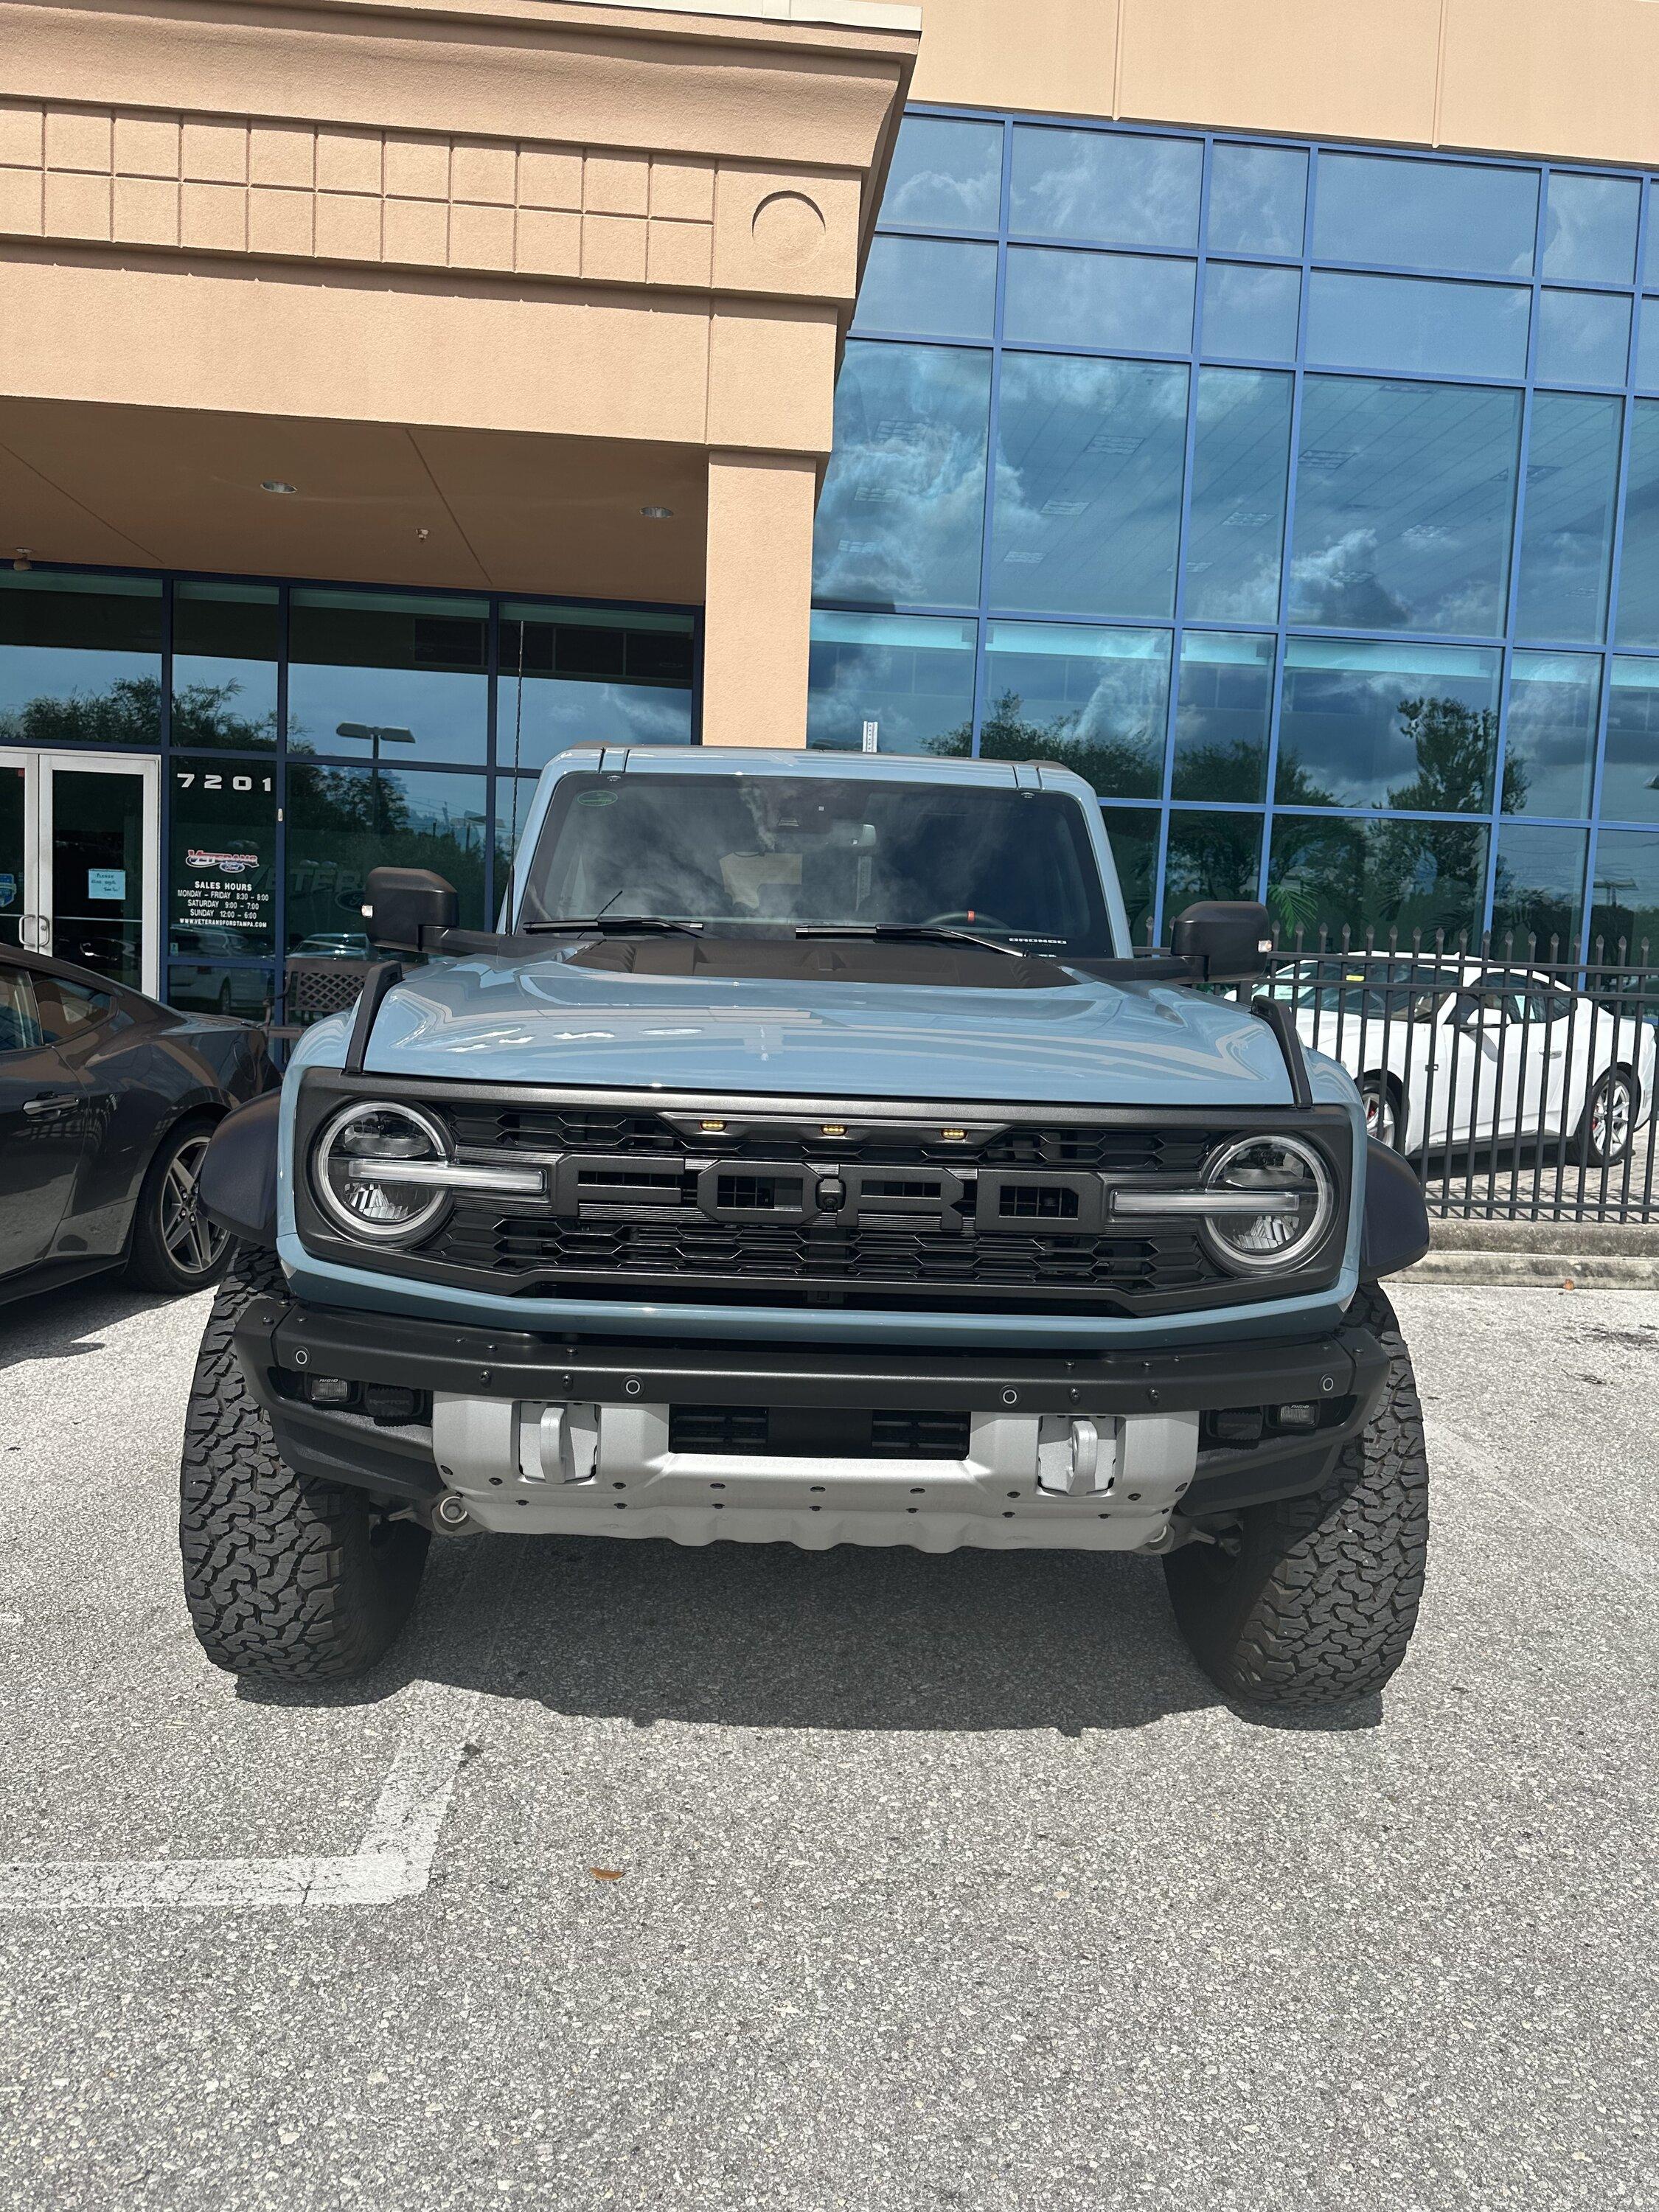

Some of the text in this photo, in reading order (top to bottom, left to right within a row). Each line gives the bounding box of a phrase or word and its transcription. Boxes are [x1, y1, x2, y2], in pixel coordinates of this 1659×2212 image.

[177, 773, 271, 792] 7201
[195, 881, 252, 891] SALES HOURS
[178, 889, 202, 897] MONDAY
[210, 891, 232, 900] FRIDAY
[236, 892, 248, 900] 8:30
[187, 899, 220, 908] SATURDAY
[225, 901, 237, 909] 9:00
[190, 908, 215, 917] SUNDAY
[244, 911, 257, 919] 6:00
[179, 918, 268, 928] WWW.VETERANSFORDTAMPA.COM
[551, 1152, 1107, 1235] FORD
